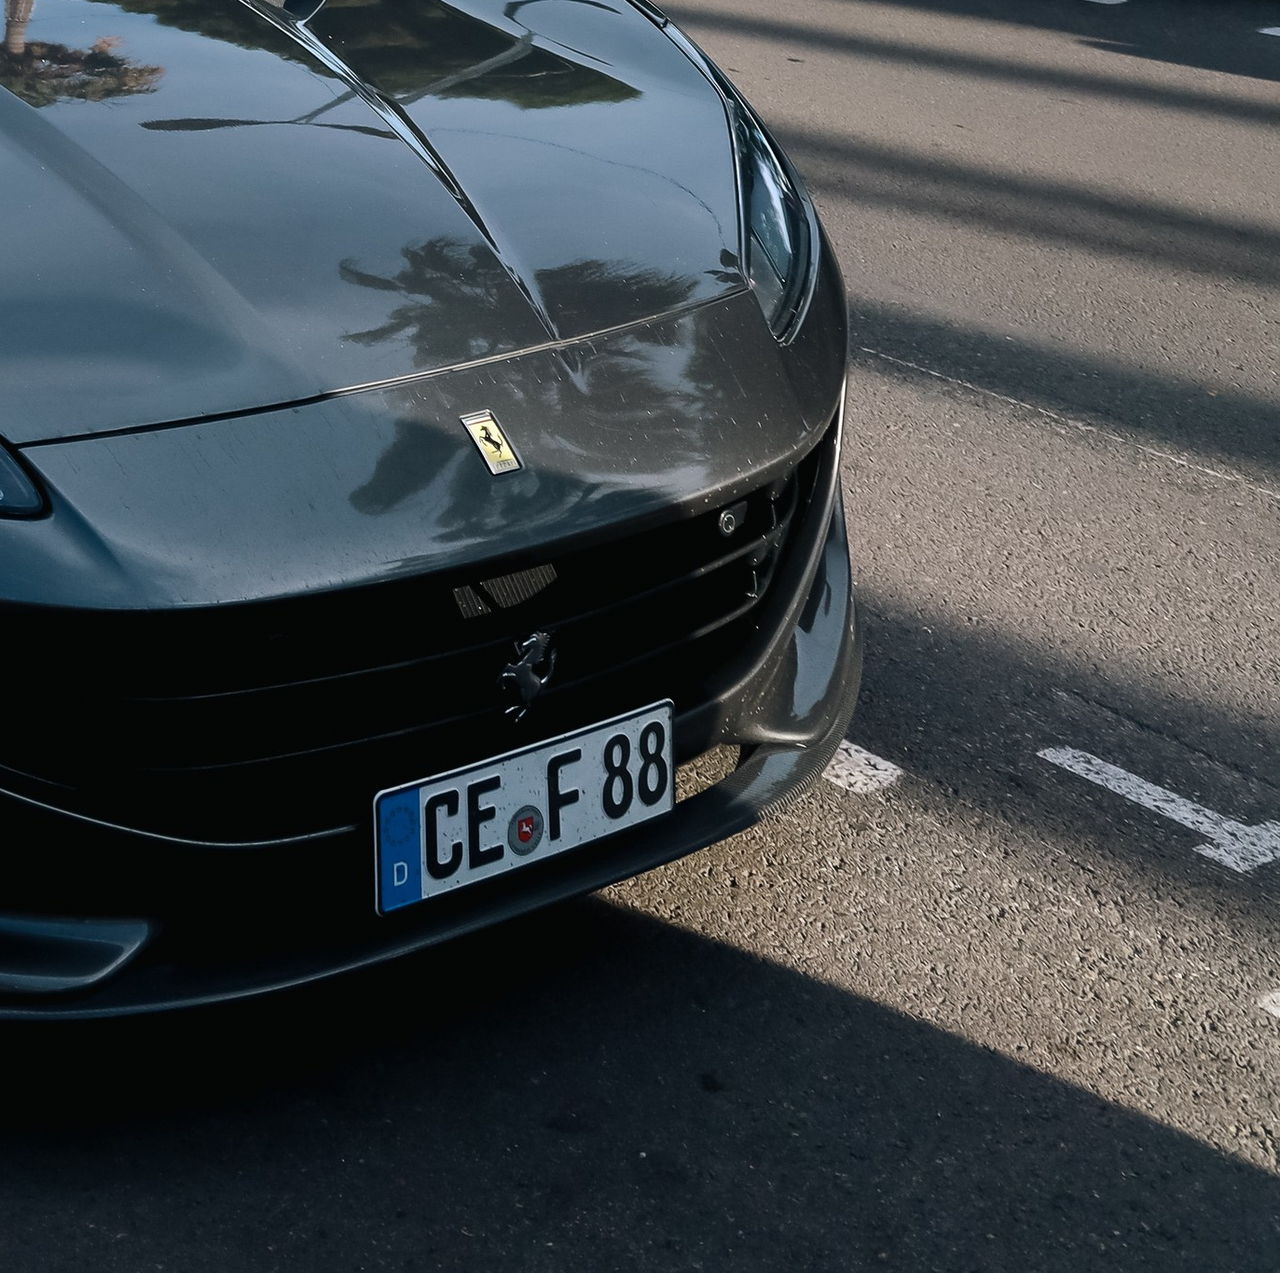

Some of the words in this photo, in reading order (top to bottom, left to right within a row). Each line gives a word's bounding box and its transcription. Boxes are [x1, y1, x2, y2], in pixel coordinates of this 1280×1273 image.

[425, 774, 505, 879] CE
[547, 748, 582, 841] F
[602, 721, 668, 819] 88
[393, 861, 408, 886] D
